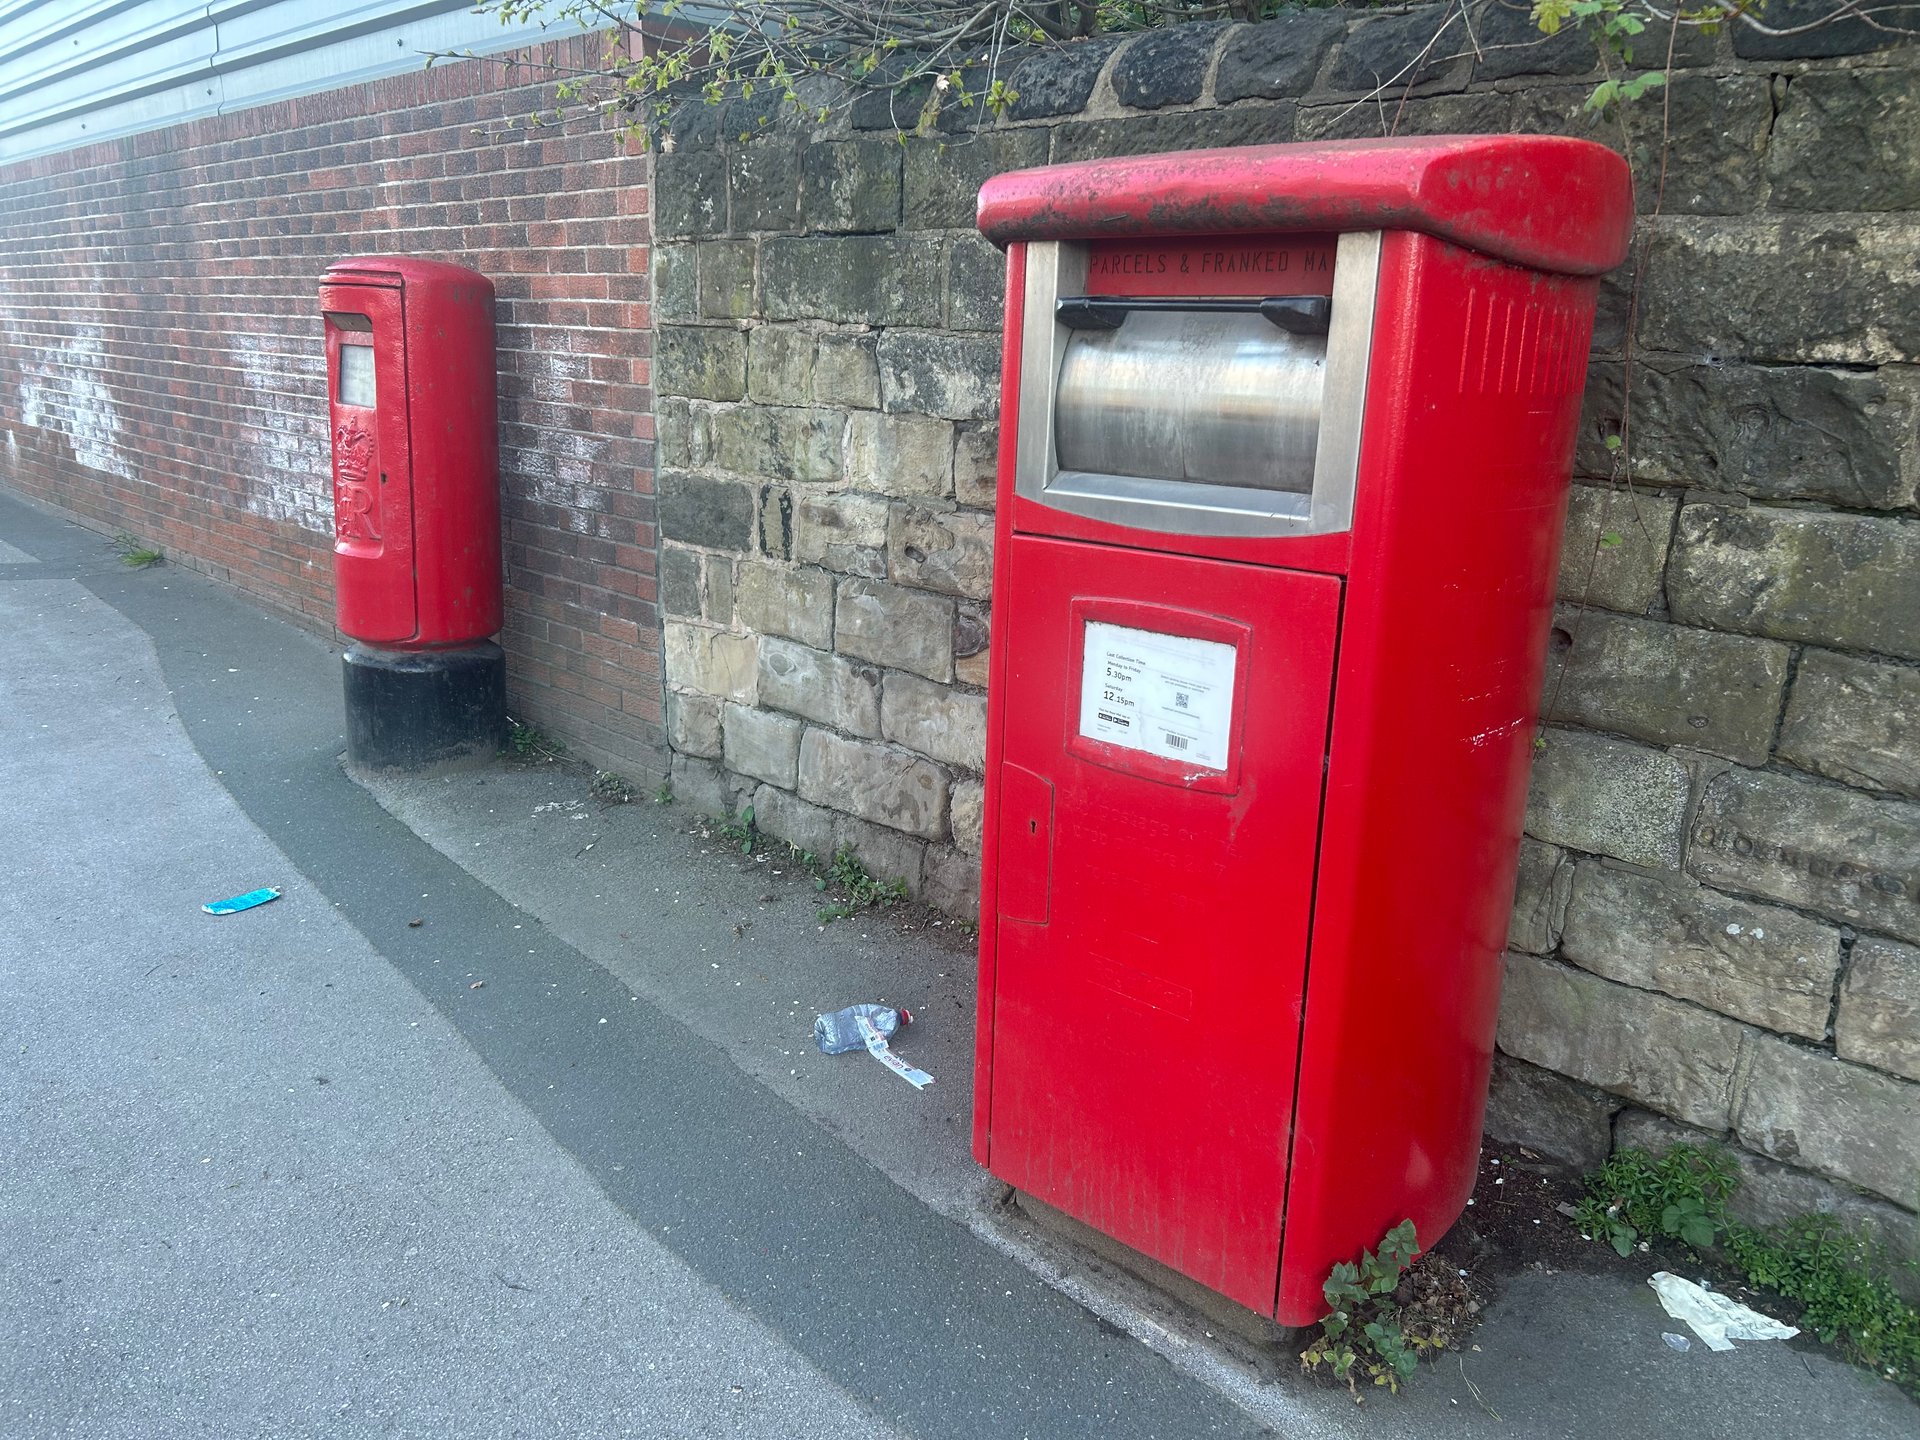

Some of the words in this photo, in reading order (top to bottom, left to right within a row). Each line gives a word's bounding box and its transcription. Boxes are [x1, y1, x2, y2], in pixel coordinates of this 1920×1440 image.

[1089, 254, 1167, 274] PARCELS
[1180, 253, 1190, 273] &
[1201, 251, 1289, 273] FRANKED
[1116, 654, 1135, 662] Collection
[1106, 667, 1132, 682] 5.30pm
[1107, 661, 1123, 669] Monday
[1129, 666, 1141, 674] Friday
[1105, 683, 1123, 692] Saturday
[1103, 690, 1135, 707] 12.15pm
